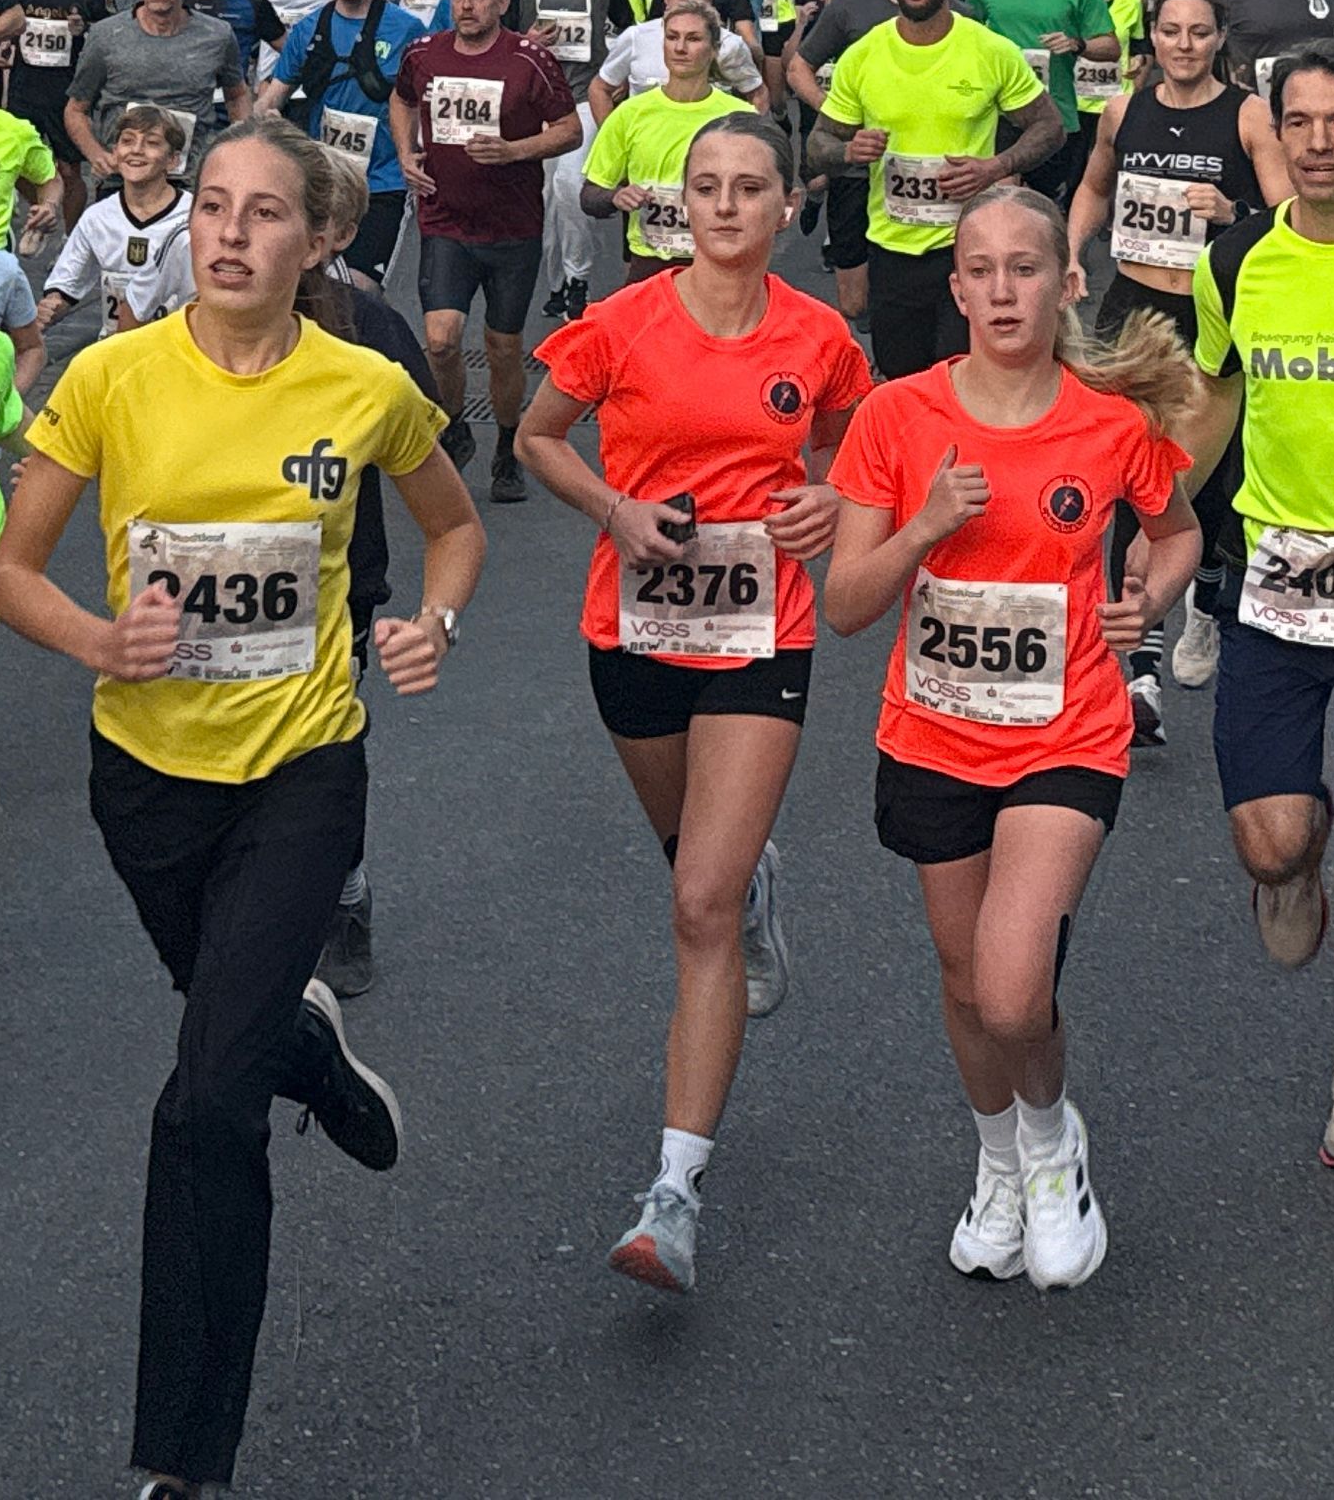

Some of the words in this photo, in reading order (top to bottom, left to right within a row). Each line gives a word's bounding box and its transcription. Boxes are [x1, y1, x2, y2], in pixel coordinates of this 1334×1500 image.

[25, 31, 67, 50] 2150
[1077, 66, 1117, 83] 2394
[438, 97, 492, 122] 2184
[1123, 152, 1224, 173] HYVIBES
[891, 174, 950, 200] 233
[1122, 199, 1192, 237] 2591
[1250, 332, 1314, 346] Bewegung
[636, 563, 759, 606] 2376
[1251, 602, 1307, 627] VOSS
[631, 619, 690, 637] VOSS
[919, 616, 1048, 674] 2556
[915, 670, 971, 702] VOSS
